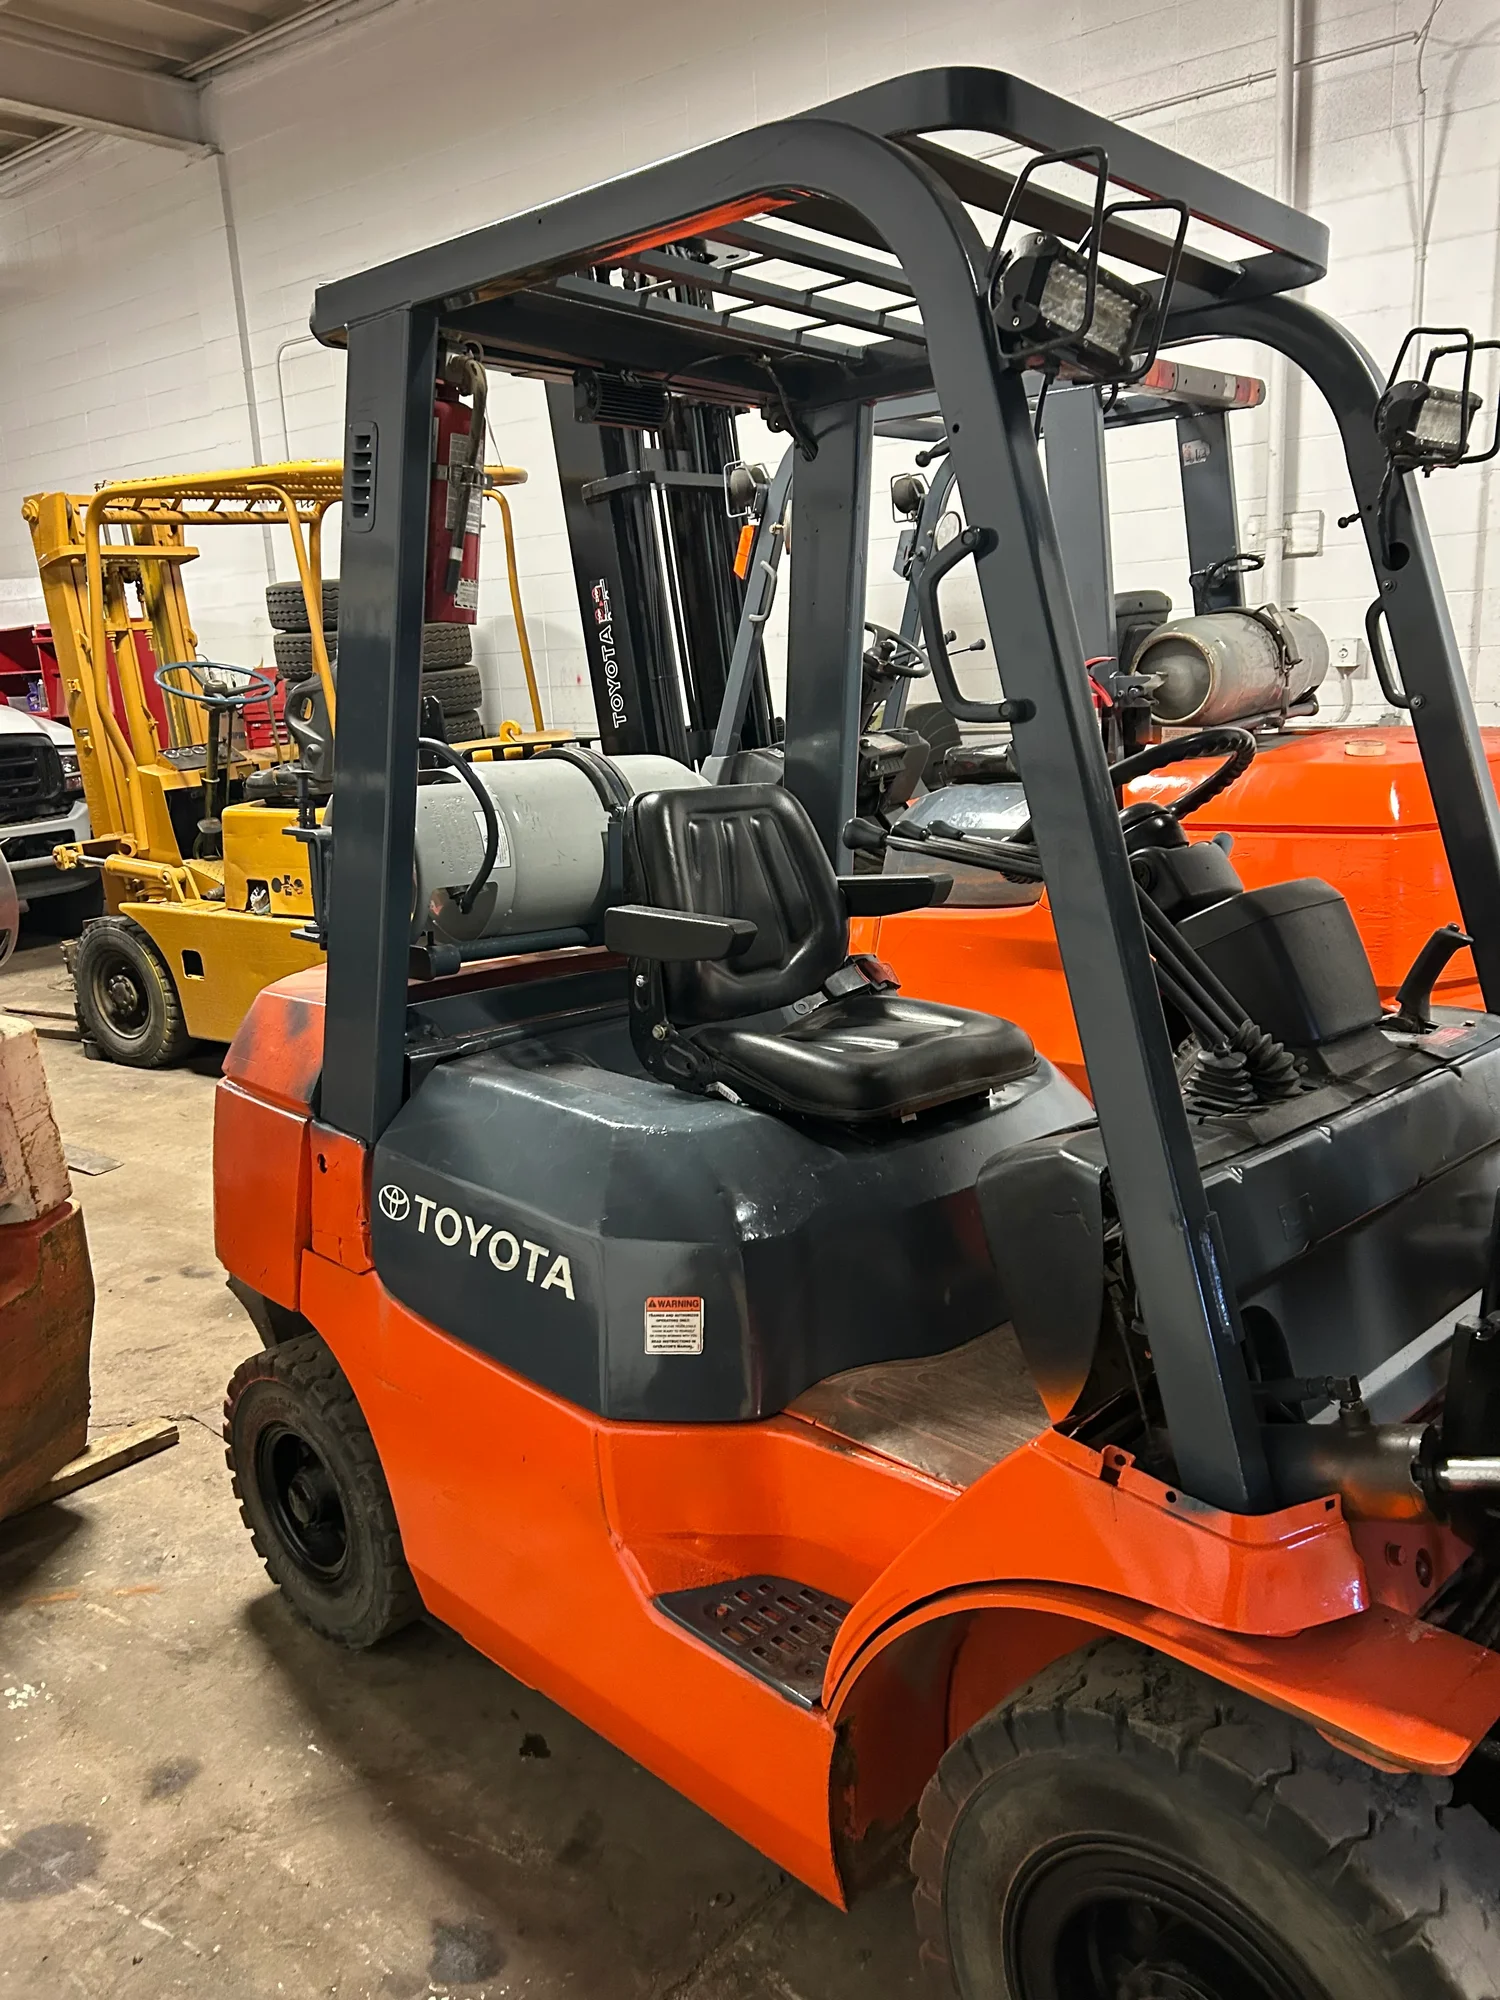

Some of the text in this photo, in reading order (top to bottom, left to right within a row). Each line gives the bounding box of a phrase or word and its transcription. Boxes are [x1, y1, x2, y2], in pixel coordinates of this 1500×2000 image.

[599, 625, 627, 728] TOYOTA
[414, 1194, 576, 1301] TOYOTA
[657, 1299, 699, 1308] WARNING
